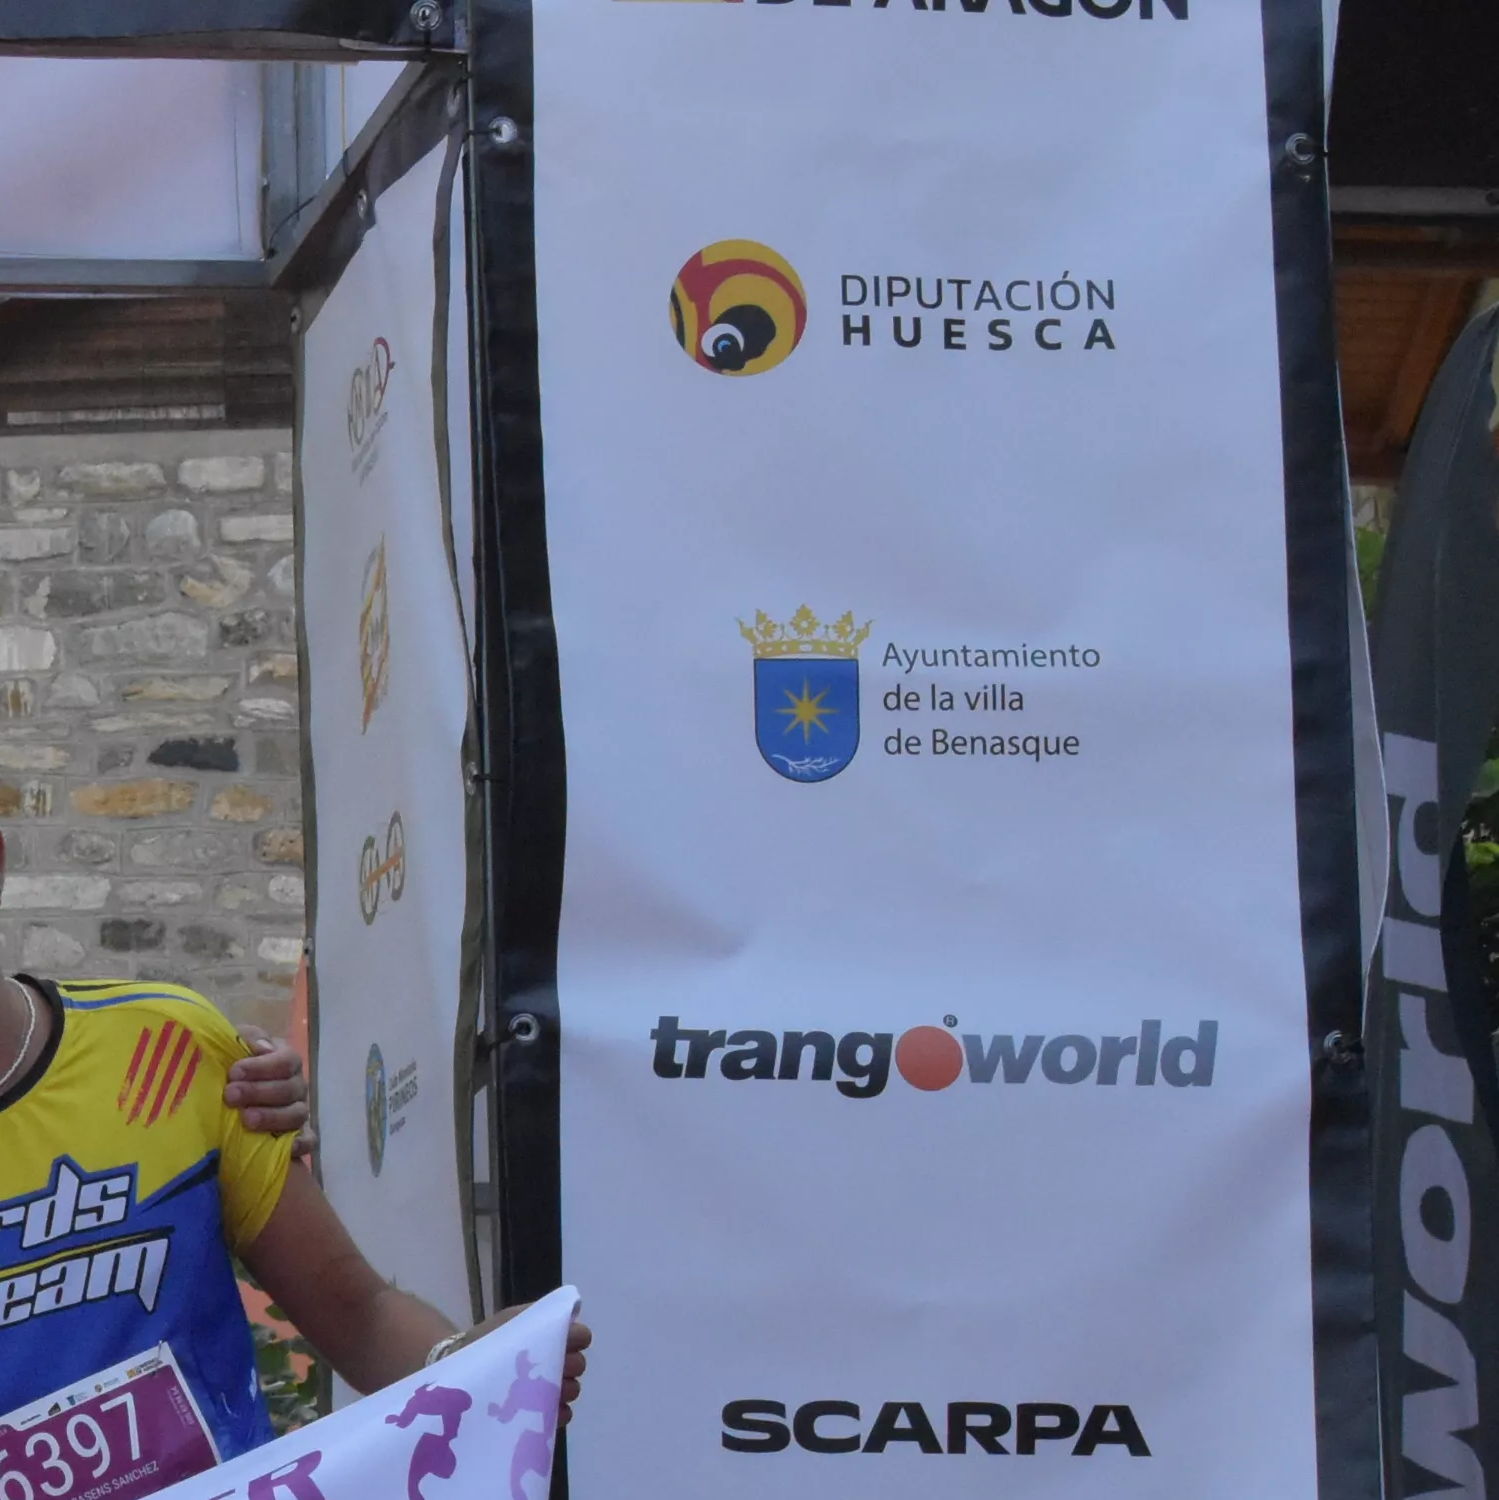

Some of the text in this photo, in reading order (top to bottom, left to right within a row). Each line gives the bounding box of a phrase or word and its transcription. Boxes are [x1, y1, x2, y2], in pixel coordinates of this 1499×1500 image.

[840, 272, 1115, 311] DIPUTACIÓN
[841, 314, 1116, 350] HUESCA
[882, 642, 1100, 675] Ayuntamiento
[882, 683, 1024, 711] de la villa
[883, 728, 1080, 761] de Benasque
[721, 1399, 1152, 1457] SCARPA
[112, 1461, 160, 1490] SANCHEZ
